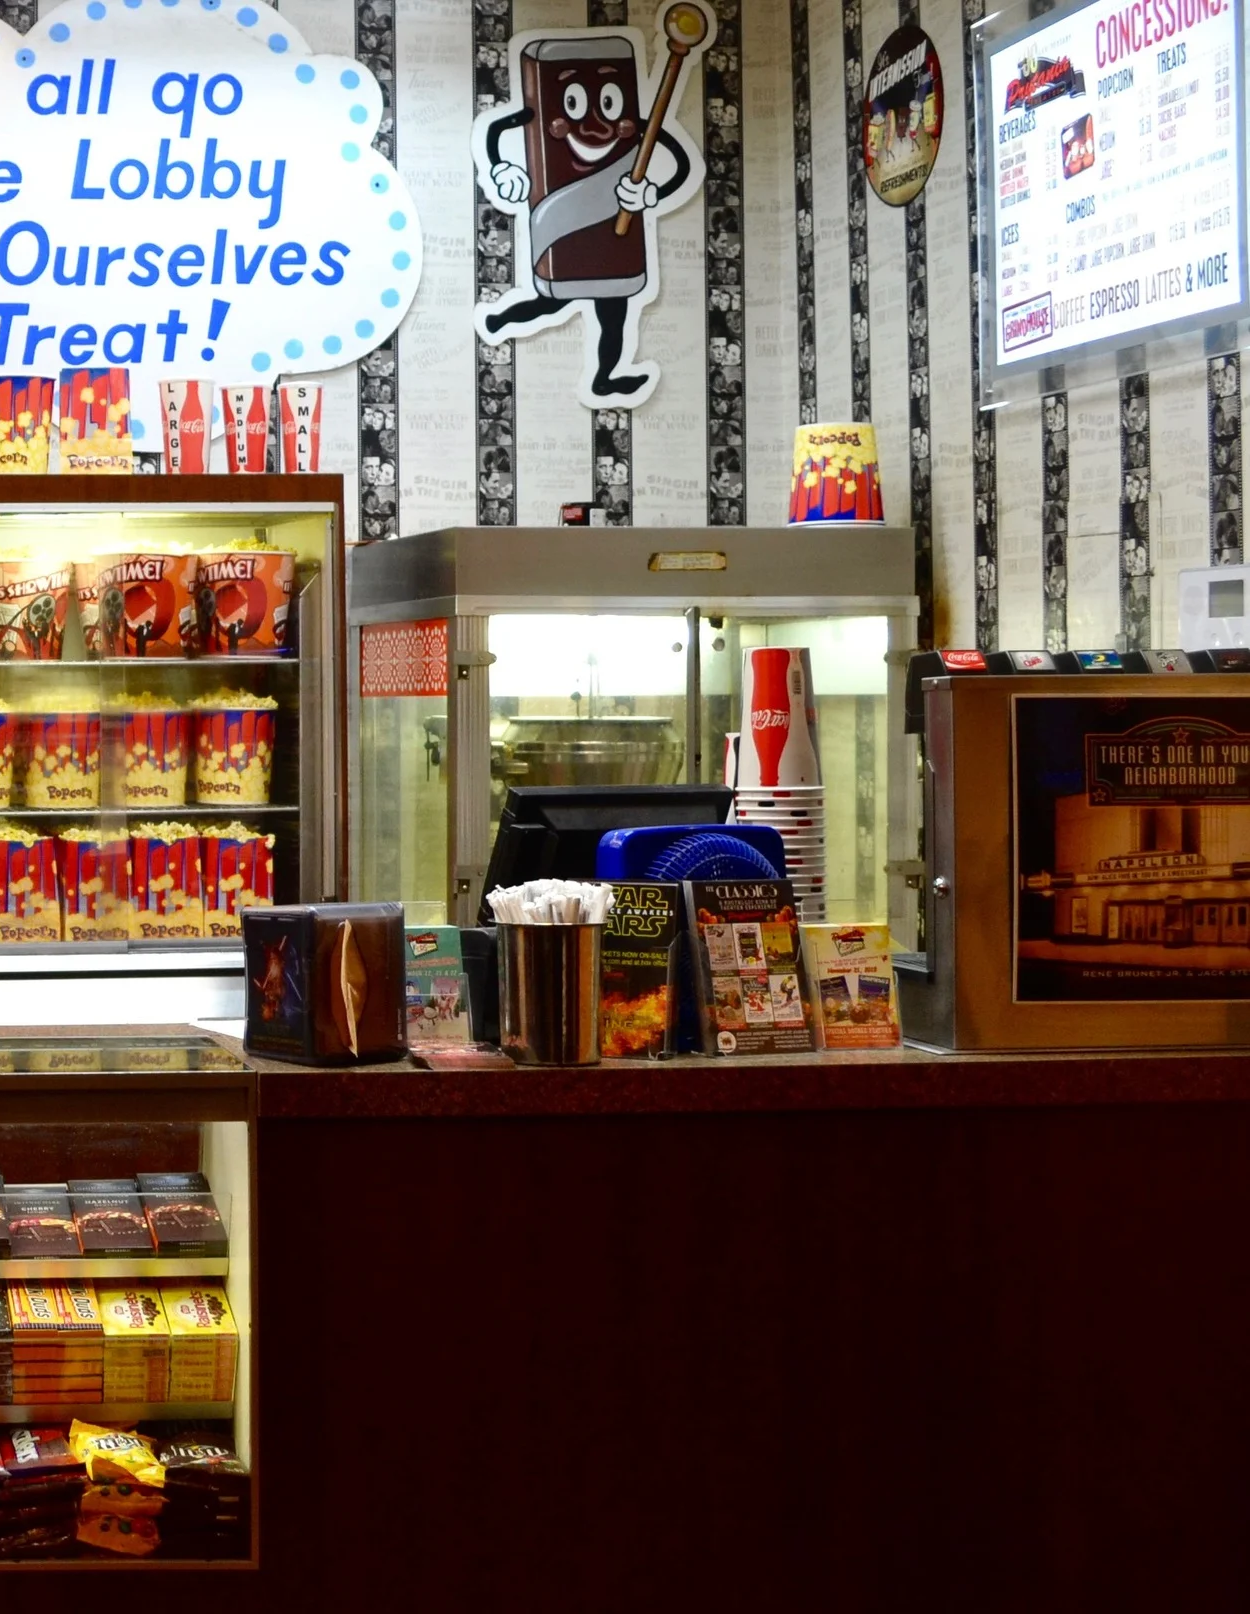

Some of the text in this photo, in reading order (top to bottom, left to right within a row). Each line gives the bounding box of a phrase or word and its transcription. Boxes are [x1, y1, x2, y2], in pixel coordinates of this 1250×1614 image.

[1157, 42, 1187, 75] TREATS
[27, 59, 116, 115] all
[71, 139, 286, 229] Lobby
[1065, 195, 1096, 224] COMBOS
[1001, 223, 1019, 247] ICEES
[1053, 252, 1229, 331] COFFEE ESPRESSO LATTES & MORE
[167, 383, 179, 467] LARGE
[235, 394, 247, 464] MEDIUM
[297, 388, 310, 472] SMALL
[66, 454, 129, 470] Popcorn
[1100, 745, 1161, 764] THERE'S
[1167, 745, 1194, 764] ONE
[1200, 745, 1215, 764] IN
[1124, 766, 1236, 785] NEIGHBORHOOD
[46, 785, 93, 801] Popcorn
[1103, 856, 1194, 870] NAPOLEON
[716, 884, 778, 899] CLASSICS
[0, 925, 57, 940] Popcorn
[70, 926, 130, 940] Popcorn
[140, 923, 200, 938] Popcorn
[1118, 970, 1162, 978] BRUNET
[31, 1298, 50, 1319] Duds
[74, 1298, 95, 1319] Duds
[125, 1291, 143, 1328] Raisinets
[190, 1290, 212, 1328] Raisinets
